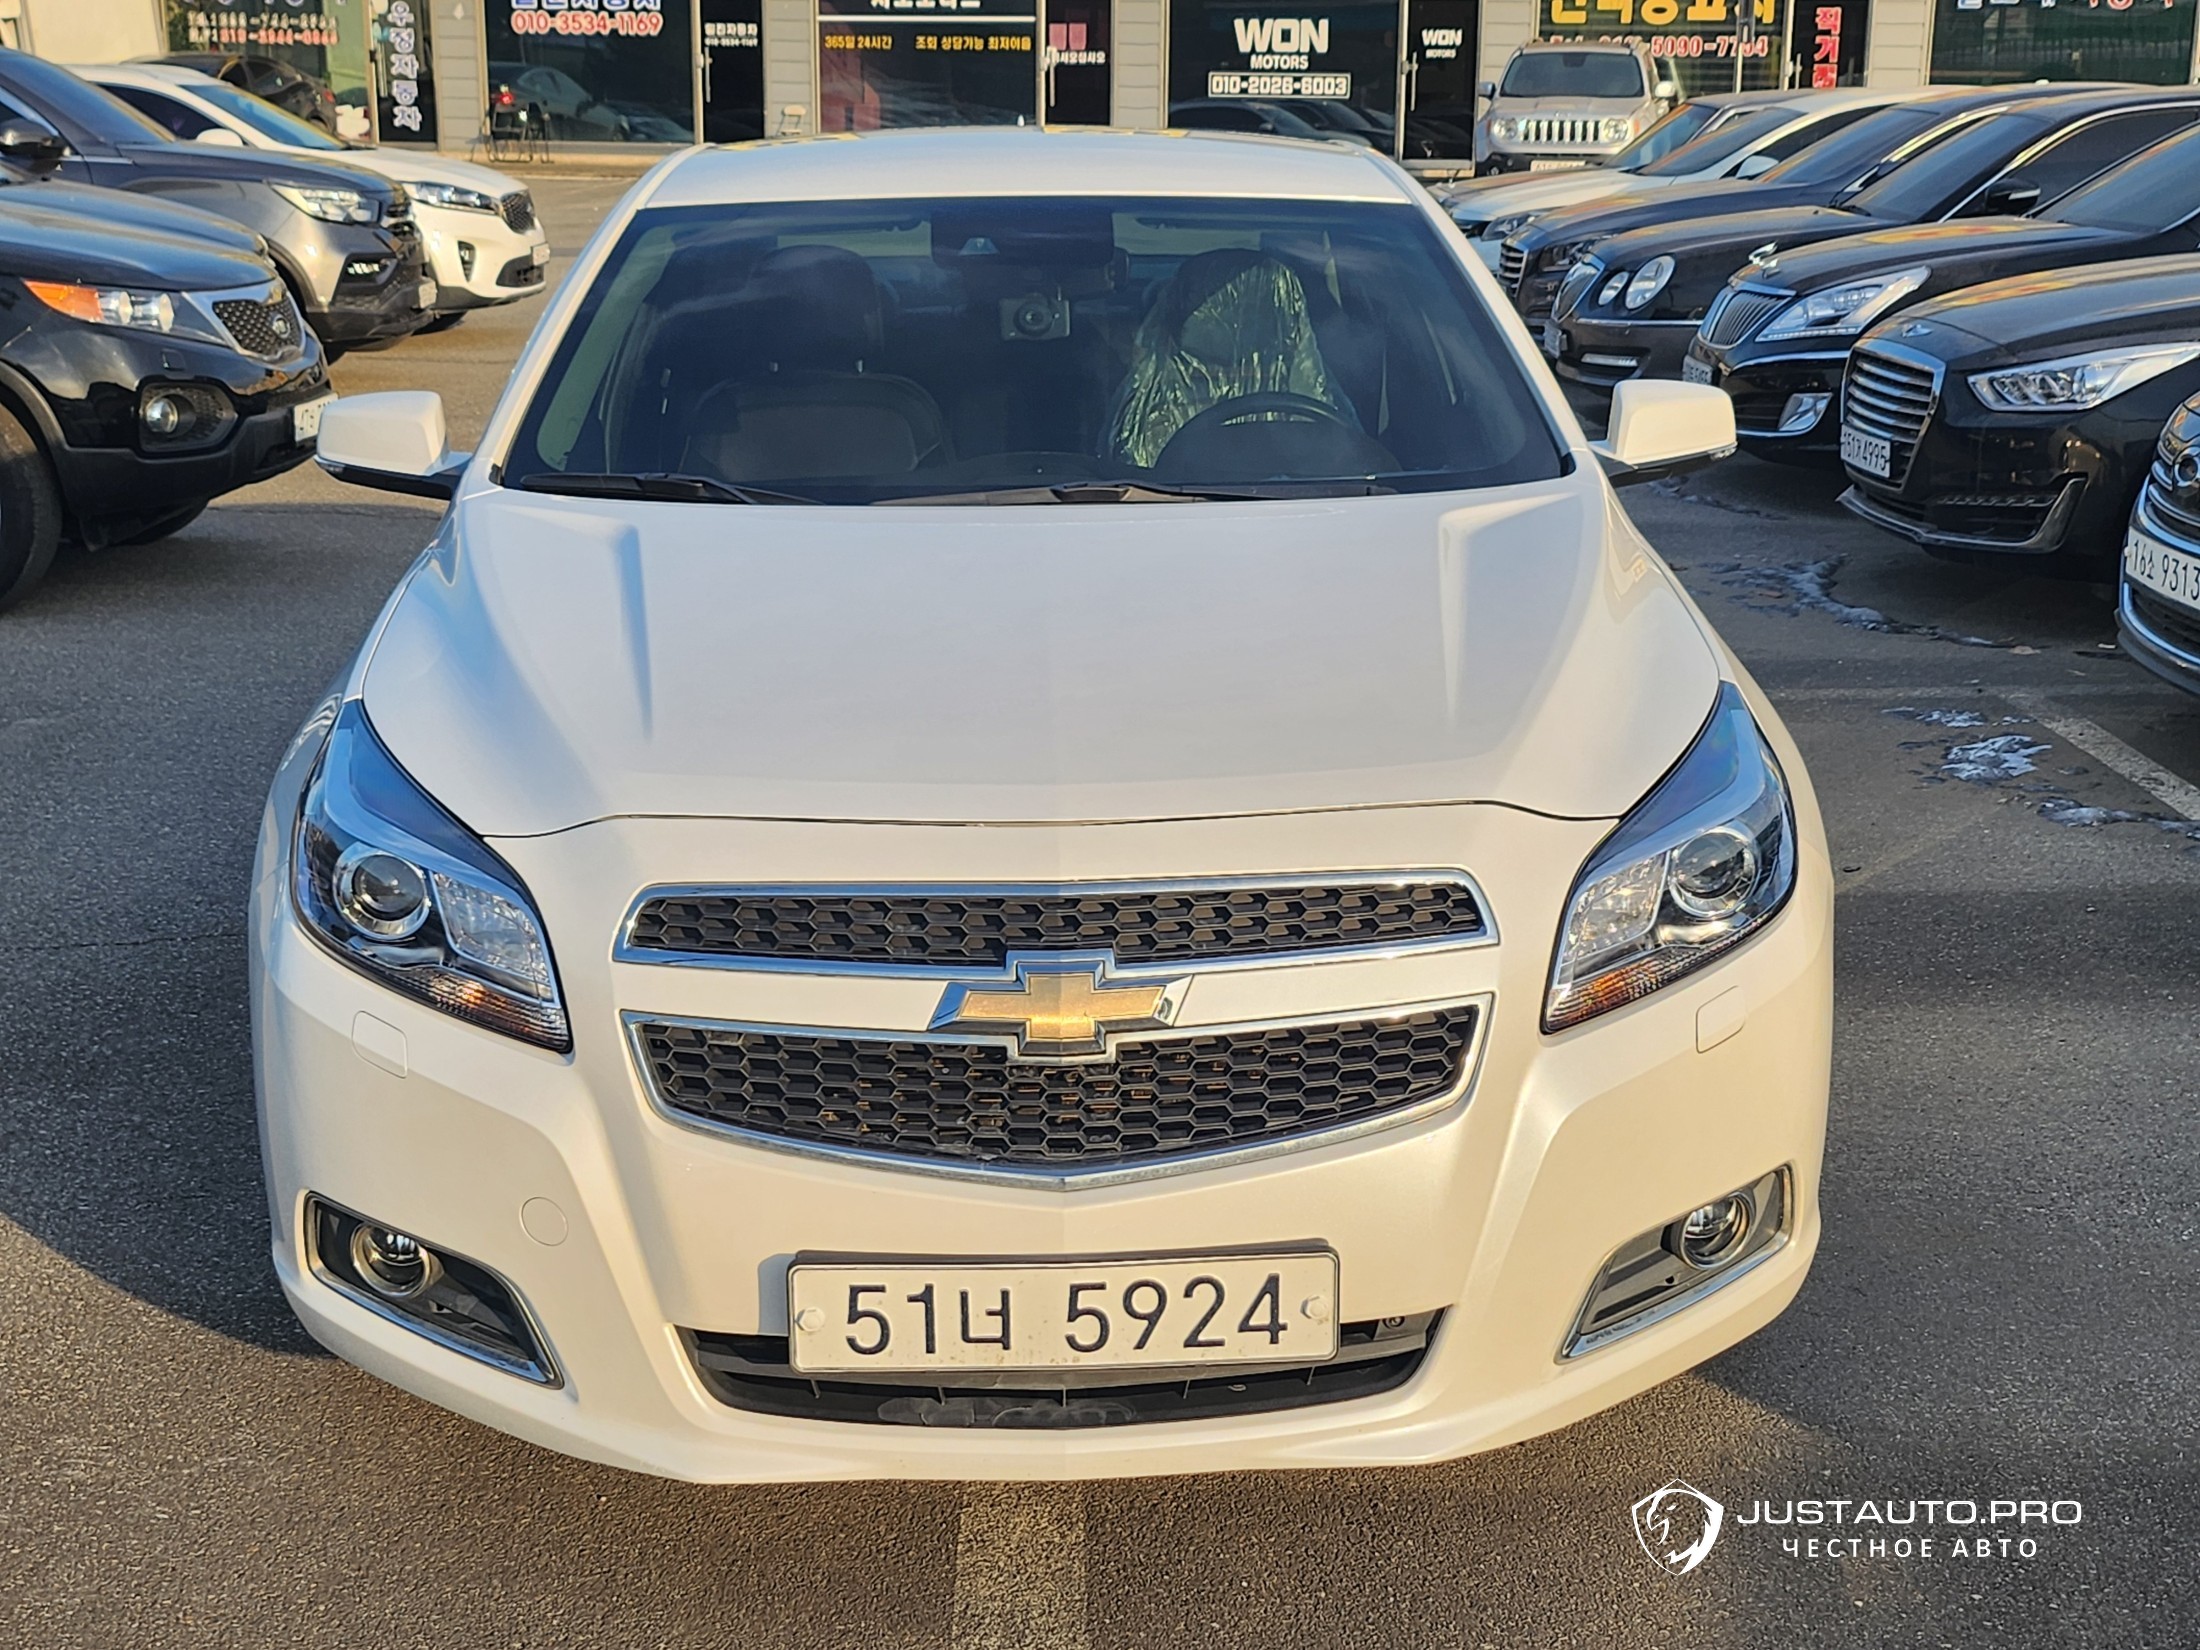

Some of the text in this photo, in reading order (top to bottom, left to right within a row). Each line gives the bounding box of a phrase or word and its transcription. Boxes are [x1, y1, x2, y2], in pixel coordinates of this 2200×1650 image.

[511, 11, 663, 36] 010-3534-1169
[824, 35, 855, 50] 365일
[857, 35, 893, 51] 24시간
[915, 35, 938, 50] 조회
[1233, 18, 1329, 53] WON
[1421, 29, 1463, 47] WON
[1250, 54, 1309, 70] MOTORS
[1425, 48, 1457, 59] MOTORS
[2133, 540, 2200, 601] 16소 9313
[845, 1272, 1289, 1355] 51너 5924
